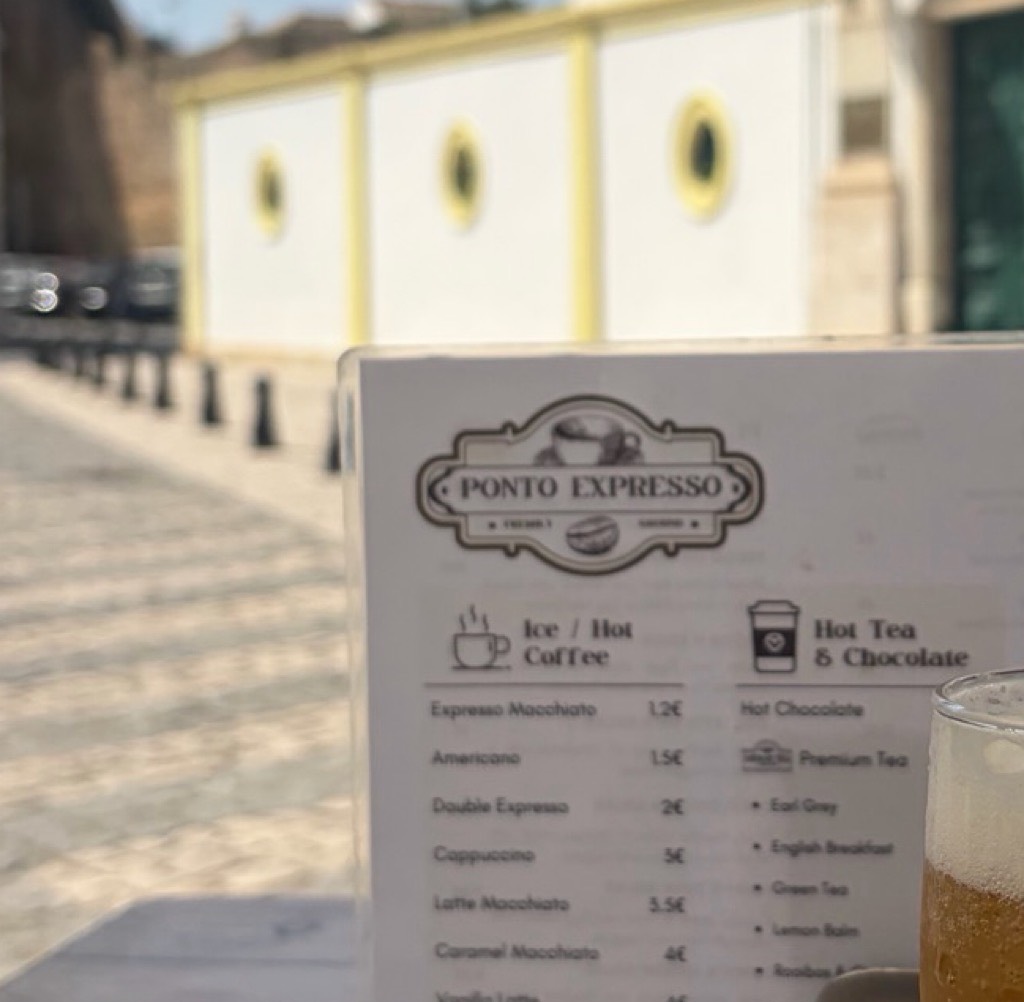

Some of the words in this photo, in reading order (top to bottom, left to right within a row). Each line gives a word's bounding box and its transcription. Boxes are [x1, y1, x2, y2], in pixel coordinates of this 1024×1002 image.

[460, 476, 558, 499] PONTO
[572, 475, 722, 497] EXPRESSO
[524, 620, 558, 639] Ice
[591, 620, 633, 639] Hot
[815, 619, 856, 639] Hot
[869, 619, 916, 639] Tea
[524, 646, 609, 666] Coffee
[815, 648, 832, 667] &
[843, 647, 969, 667] Chocolate
[431, 701, 503, 720] Expresso
[509, 701, 597, 717] Macchiato
[741, 702, 769, 716] Hot
[775, 701, 864, 716] Chocolate
[432, 751, 521, 765] Americano
[799, 752, 872, 767] Premium
[877, 752, 908, 767] Tea
[433, 798, 491, 814] Double
[496, 798, 569, 816] Expresso
[661, 799, 684, 815] 2€
[770, 799, 798, 812] Earl
[802, 799, 838, 816] Grey
[433, 846, 535, 865] Cappuccino
[771, 840, 822, 856] English
[826, 840, 894, 854] Breakfast
[772, 882, 818, 896] Green
[823, 881, 848, 896] Tea
[434, 895, 475, 910] Latte
[480, 895, 570, 911] Macchiato
[773, 924, 820, 936] Lemon
[435, 943, 506, 960] Caramel
[511, 945, 600, 960] Macchiato
[664, 946, 686, 962] 4€
